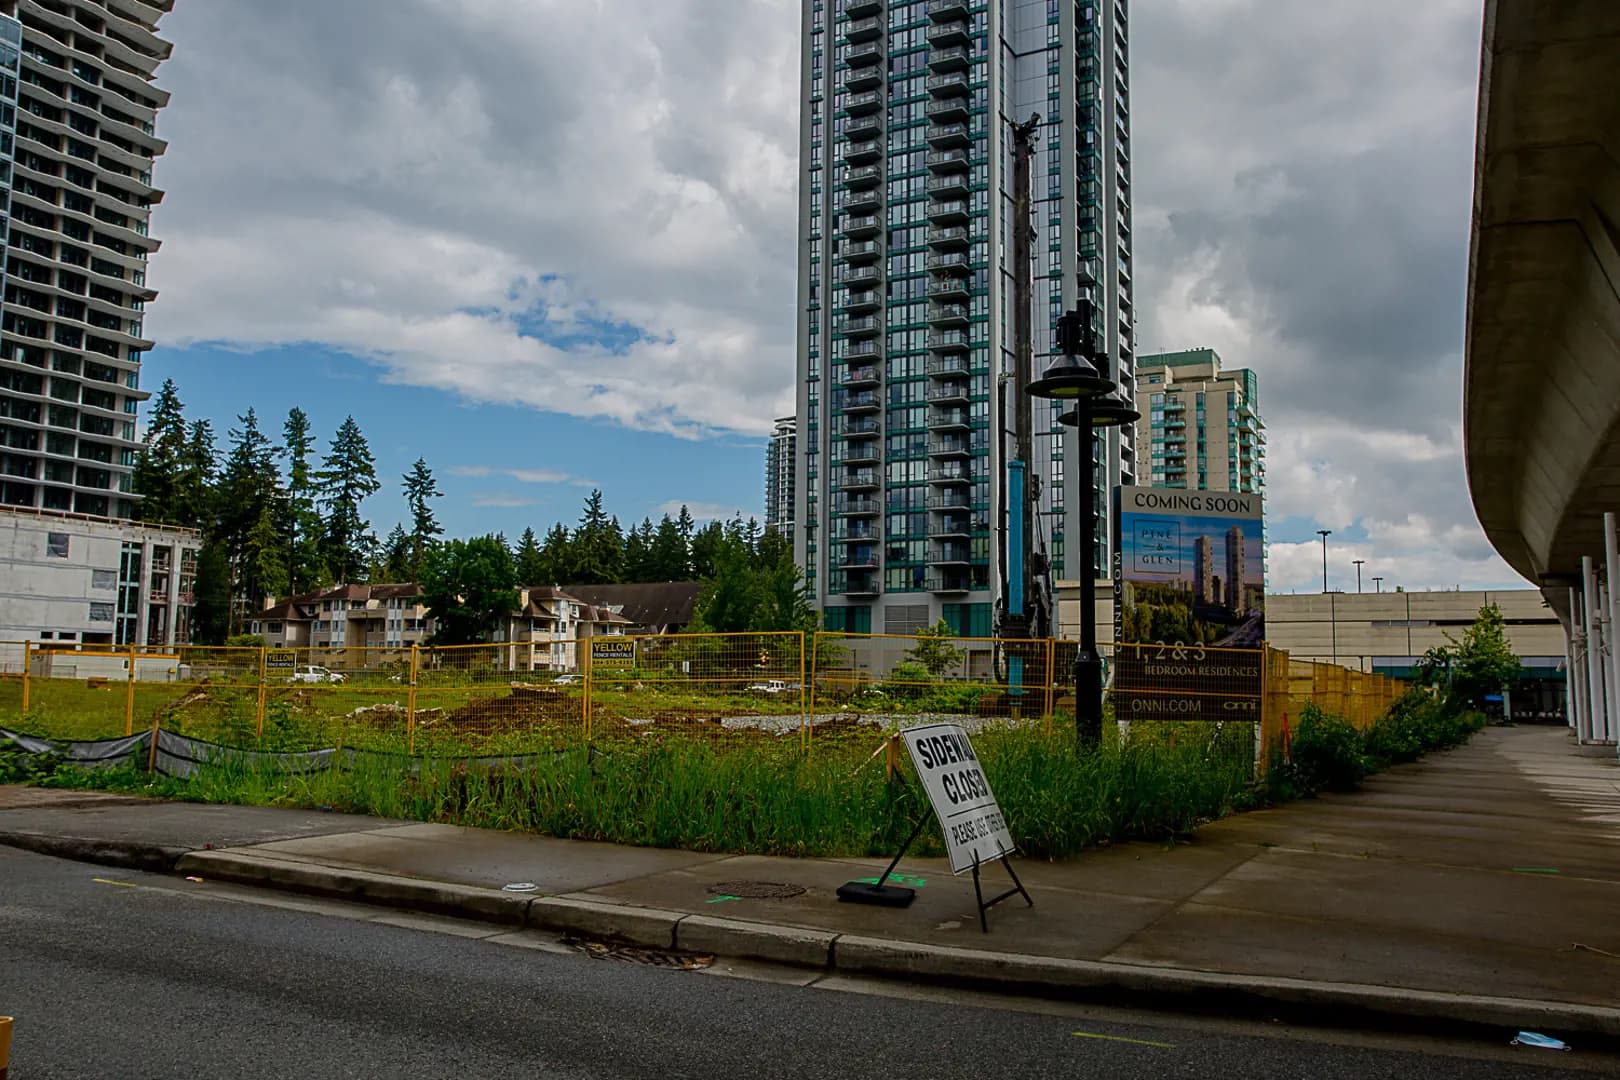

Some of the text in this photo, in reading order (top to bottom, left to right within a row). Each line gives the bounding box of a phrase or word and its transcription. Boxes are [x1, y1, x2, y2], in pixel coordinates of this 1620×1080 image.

[1135, 493, 1250, 513] COMING SOON
[1142, 529, 1173, 539] PINE
[1142, 555, 1173, 564] GLEN
[1114, 552, 1122, 652] ONNI.COM
[594, 643, 632, 652] YELLOW
[1155, 640, 1166, 660] 2
[1172, 640, 1188, 661] &
[1193, 641, 1206, 661] 3
[1145, 665, 1258, 677] BEDROOM RESIDENCES
[1131, 698, 1201, 712] ONNI.COM
